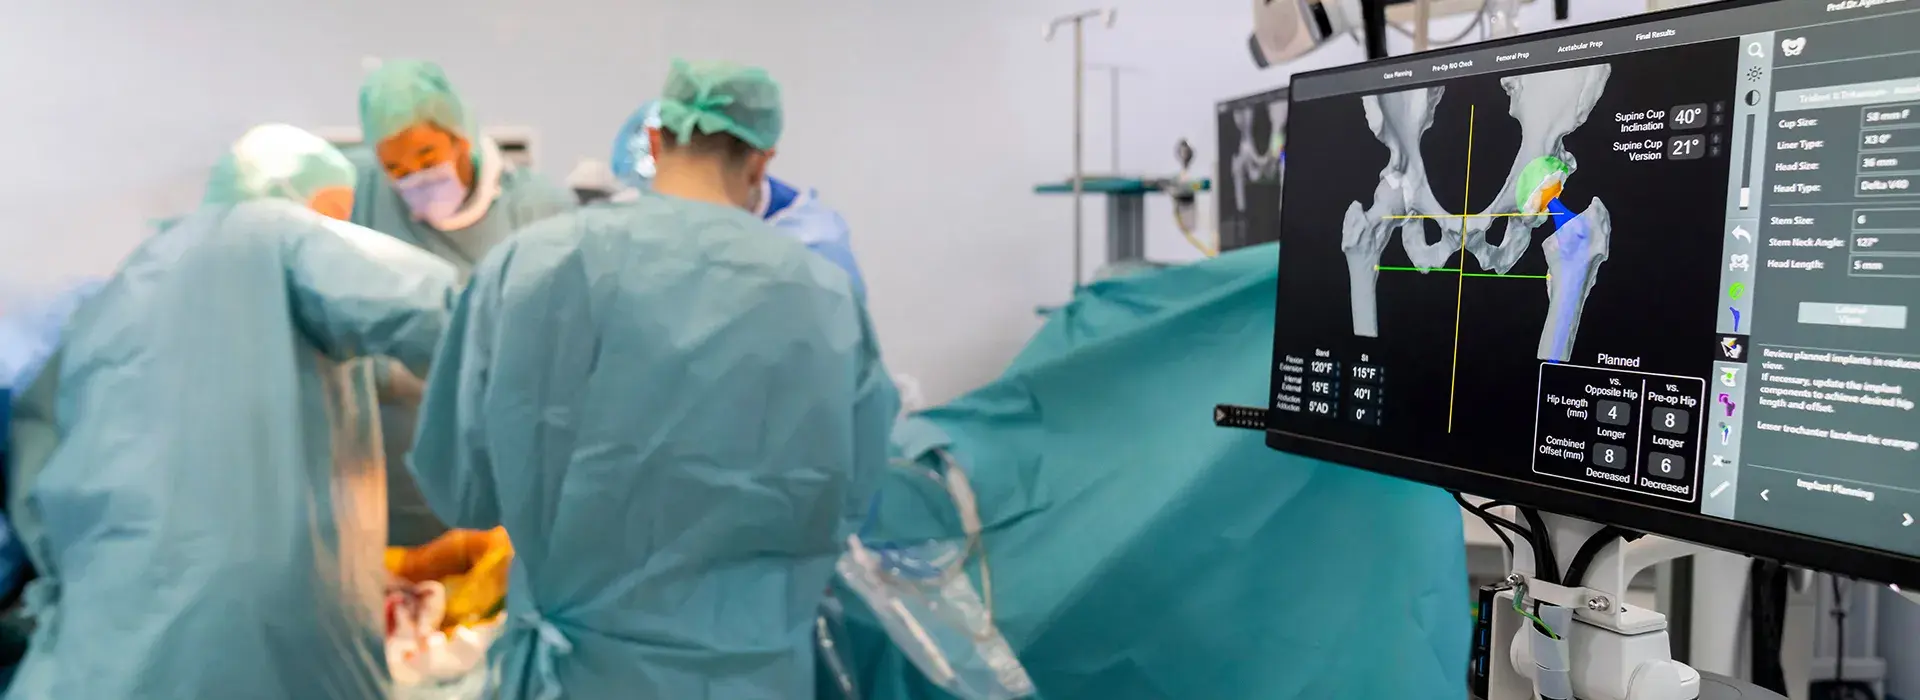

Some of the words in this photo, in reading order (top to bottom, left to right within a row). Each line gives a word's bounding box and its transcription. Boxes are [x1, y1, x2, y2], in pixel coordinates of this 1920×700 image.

[1636, 32, 1650, 40] Final
[1652, 29, 1676, 38] Results
[1558, 42, 1588, 52] Acetabular
[1589, 40, 1603, 48] Prep
[1496, 53, 1517, 62] Femoral
[1432, 64, 1448, 72] Pre-Op
[1615, 112, 1644, 122] Supine
[1646, 109, 1665, 120] Cup
[1674, 108, 1701, 125] 40°
[1621, 121, 1664, 132] Inclination
[1778, 120, 1796, 129] Cup
[1797, 118, 1818, 127] Size:
[1613, 142, 1642, 152] Supine
[1644, 139, 1662, 150] Cup
[1672, 139, 1699, 155] 21°
[1777, 142, 1798, 150] Liner
[1800, 140, 1824, 150] Type:
[1629, 151, 1661, 161] Version
[1775, 162, 1798, 171] Head
[1798, 161, 1819, 170] Size:
[1774, 184, 1796, 193] Head
[1797, 184, 1821, 194] Type:
[1770, 216, 1792, 225] Stem
[1793, 216, 1814, 225] Size:
[1769, 238, 1790, 247] Stem
[1791, 238, 1814, 247] Neck
[1814, 238, 1846, 249] Angle:
[1767, 260, 1790, 268] Head
[1791, 260, 1824, 270] Length:
[1598, 353, 1640, 368] Planned
[1764, 348, 1794, 359] Review
[1794, 351, 1831, 362] planned
[1831, 353, 1872, 365] implants
[1872, 356, 1883, 366] in
[1311, 361, 1333, 374] 120°F
[1762, 360, 1784, 370] view.
[1352, 366, 1376, 379] 115°F
[1312, 381, 1329, 394] 15°E
[1609, 378, 1621, 386] vs.
[1666, 384, 1679, 392] vs.
[1761, 372, 1770, 381] If
[1770, 375, 1812, 387] necessary,
[1813, 378, 1846, 389] update
[1846, 380, 1863, 391] the
[1863, 382, 1902, 394] implant
[1585, 384, 1621, 397] Opposite
[1623, 389, 1638, 400] Hip
[1760, 386, 1812, 398] components
[1812, 390, 1824, 400] to
[1824, 391, 1860, 403] achieve
[1547, 394, 1560, 405] Hip
[1561, 396, 1588, 408] Length
[1648, 392, 1678, 405] Pre-op
[1680, 395, 1697, 408] Hip
[1759, 396, 1787, 409] length
[1787, 401, 1805, 410] and
[1805, 402, 1835, 413] offset.
[1356, 409, 1366, 420] 0°
[1567, 408, 1588, 420] (mm)
[1608, 406, 1617, 420] 4
[1664, 412, 1675, 428] 8
[1597, 426, 1626, 440] Longer
[1757, 421, 1782, 432] Lesser
[1782, 426, 1829, 438] trochanter
[1546, 435, 1585, 450] Combined
[1653, 435, 1684, 449] Longer
[1539, 445, 1562, 457] Offset
[1563, 448, 1584, 462] (mm)
[1604, 449, 1614, 463] 8
[1661, 458, 1672, 473] 6
[1586, 467, 1630, 484] Decreased
[1641, 477, 1689, 494] Decreased
